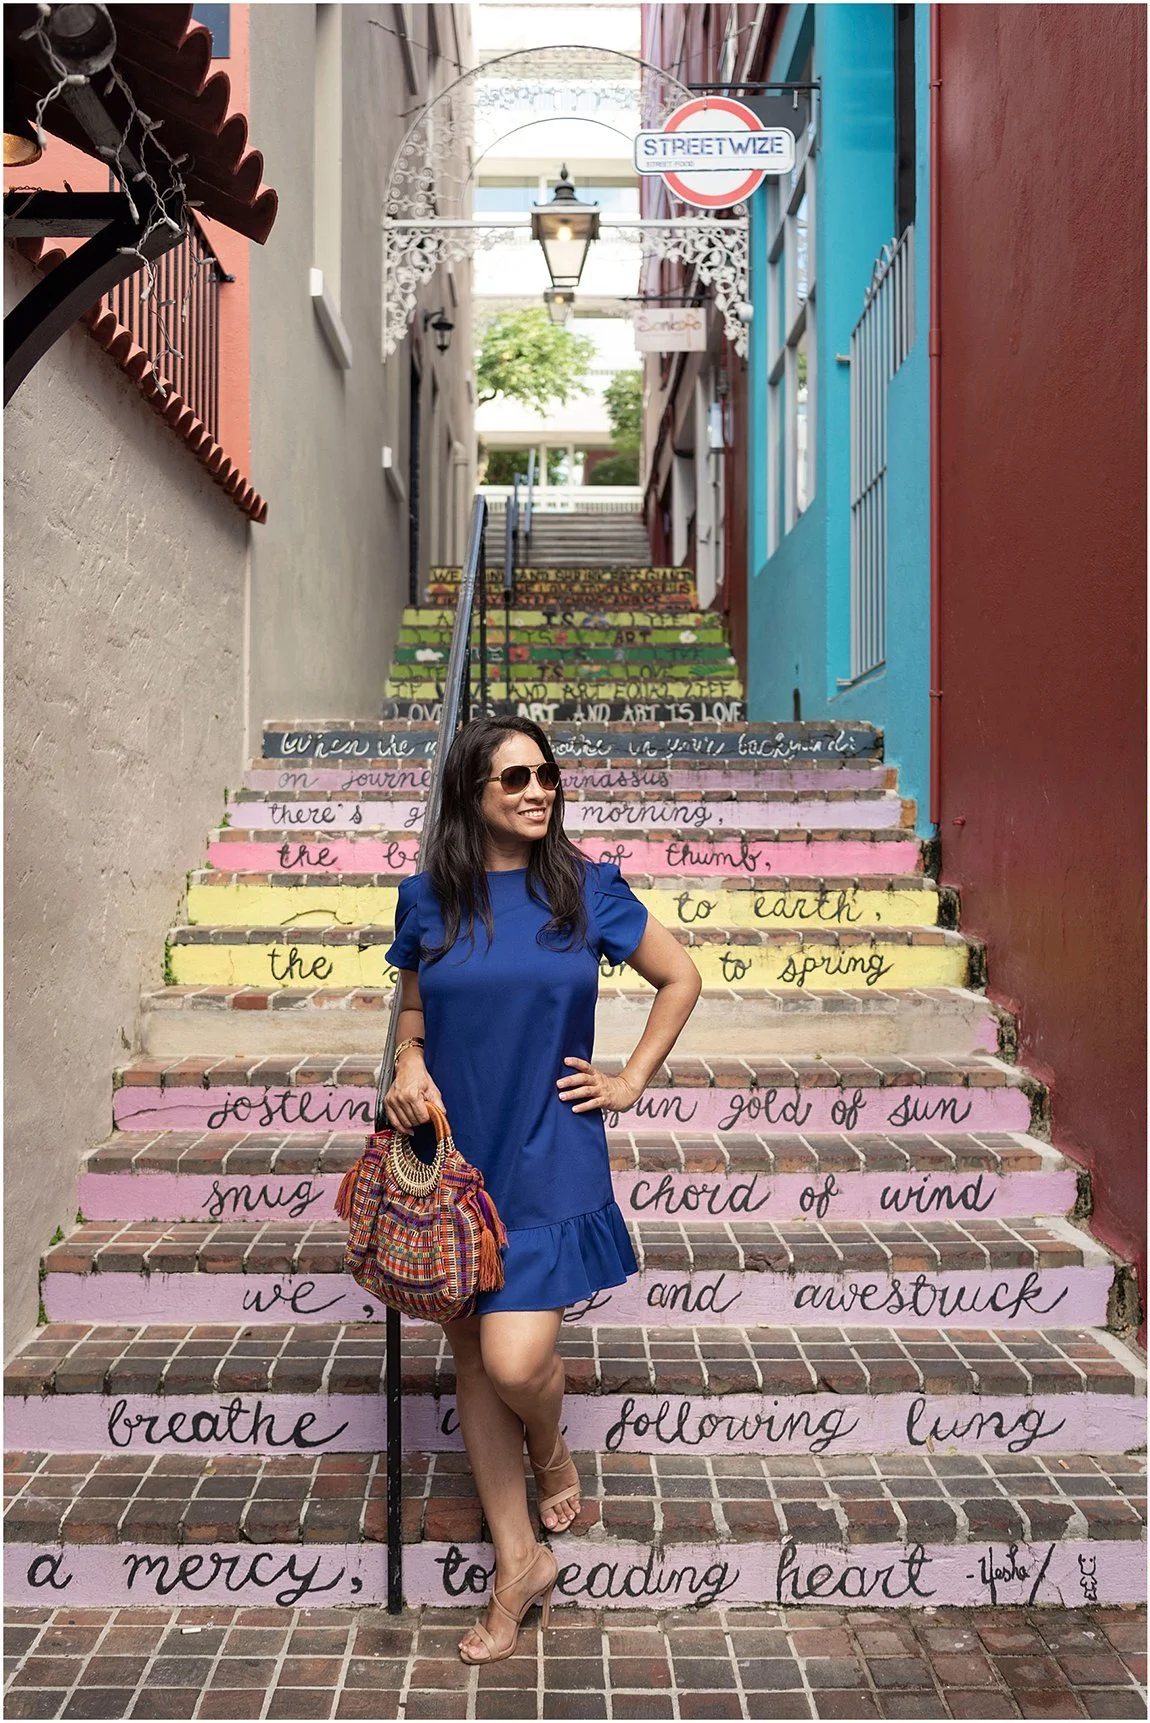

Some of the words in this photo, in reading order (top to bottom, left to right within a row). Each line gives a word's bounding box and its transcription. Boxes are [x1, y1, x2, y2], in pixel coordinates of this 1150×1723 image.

[644, 136, 784, 156] STREETWIZE
[646, 160, 672, 168] STREET
[568, 703, 611, 722] AND
[619, 703, 661, 722] ART
[665, 702, 695, 722] IS
[278, 771, 319, 789] on
[341, 769, 432, 790] journe
[561, 771, 669, 789] arnassus
[269, 802, 363, 824] there's
[582, 803, 724, 827] morning,
[276, 844, 338, 869] the
[600, 844, 633, 868] of
[666, 843, 772, 872] thumb,
[673, 891, 718, 923] to
[267, 947, 334, 980] the
[719, 950, 752, 982] to
[776, 946, 894, 987] spring
[207, 1090, 377, 1130] jostlin
[717, 1088, 812, 1131] gold
[831, 1094, 868, 1130] of
[889, 1094, 972, 1127] sun
[202, 1179, 325, 1218] snug
[630, 1174, 770, 1215] chord
[800, 1185, 840, 1218] of
[880, 1175, 997, 1213] wind
[647, 1273, 743, 1313] and
[794, 1272, 1069, 1322] awestruck
[108, 1399, 349, 1448] breathe
[606, 1398, 861, 1453] following
[906, 1398, 1066, 1453] lung
[27, 1553, 73, 1589] a
[125, 1551, 363, 1607] mercy,
[434, 1546, 496, 1597] to
[556, 1555, 740, 1607] eading
[776, 1539, 937, 1604] heart
